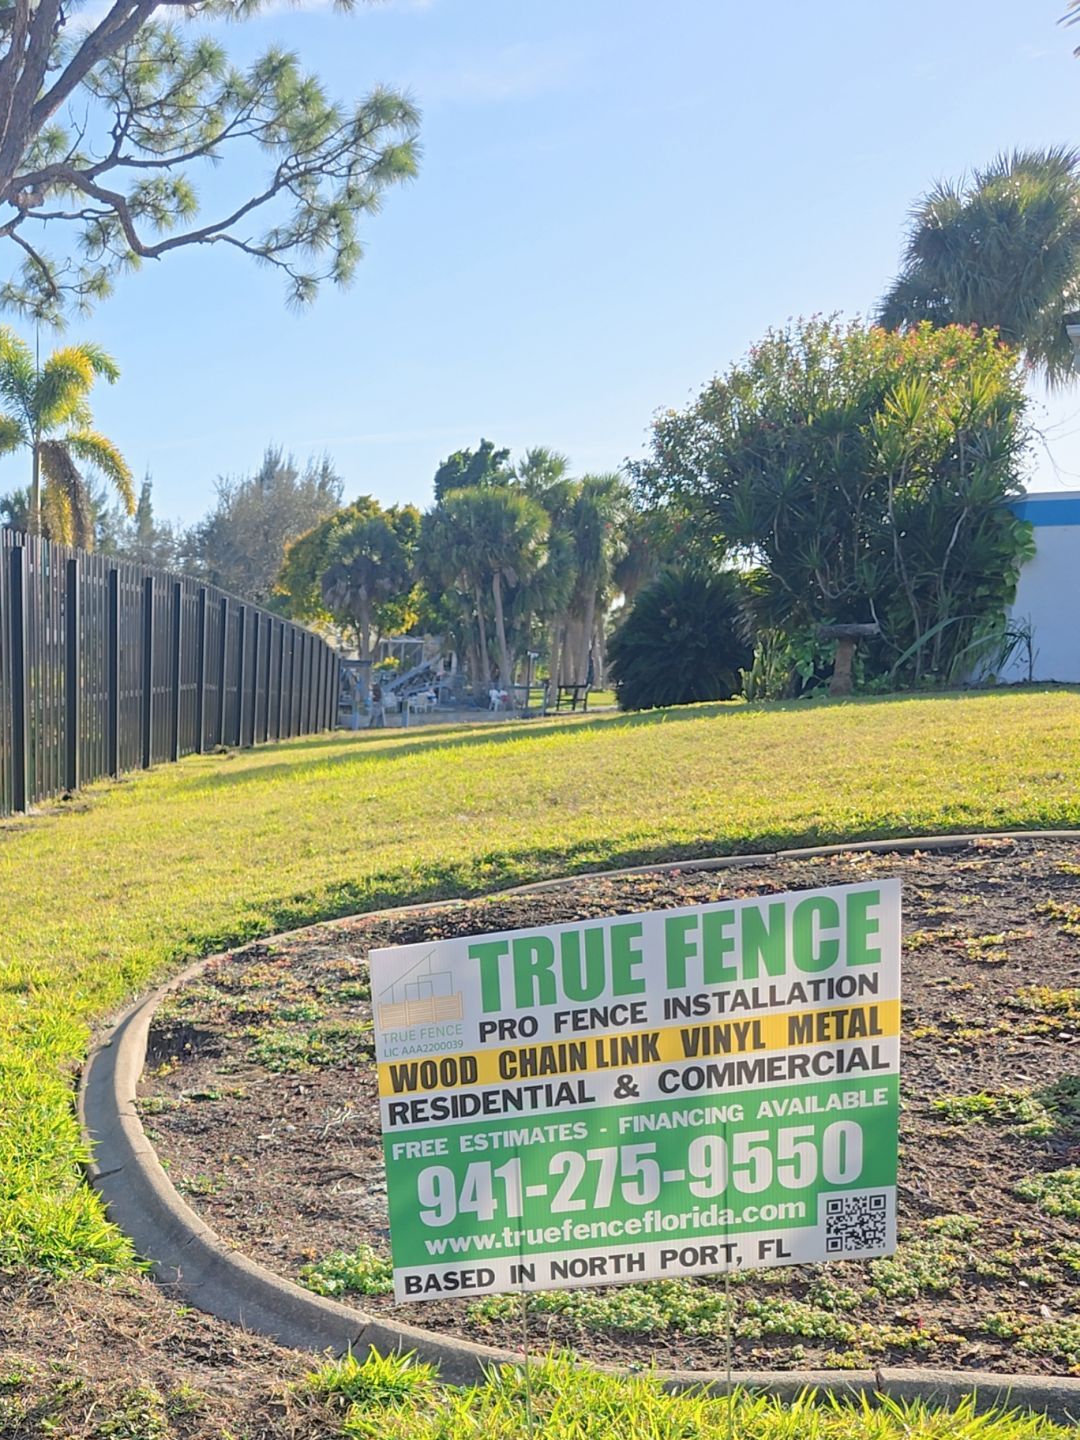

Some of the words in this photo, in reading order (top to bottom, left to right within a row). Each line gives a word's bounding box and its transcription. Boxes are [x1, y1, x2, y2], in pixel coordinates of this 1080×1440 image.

[468, 921, 646, 1013] TRUE
[665, 890, 882, 990] FENCE
[382, 1030, 417, 1044] TRUE
[421, 1024, 463, 1039] FENCE
[479, 1015, 538, 1043] PRO
[554, 1001, 648, 1034] FENCE
[664, 972, 879, 1021] INSTALLATION
[384, 1047, 400, 1057] LIC
[401, 1040, 464, 1056] AAA2200039
[389, 1056, 478, 1093] WOOD
[680, 1021, 766, 1058] VINYL
[787, 1005, 883, 1046] METAL
[388, 1080, 596, 1126] RESIDENTIAL
[613, 1074, 640, 1100] &
[657, 1045, 890, 1094] COMMERCIAL
[392, 1138, 449, 1161] FREE
[460, 1122, 589, 1153] ESTIMATES
[619, 1104, 744, 1135] FINANCING
[756, 1088, 889, 1119] AVAILABLE
[417, 1121, 864, 1228] 941-275-9550
[425, 1201, 806, 1256] www.truefenceflorida.com
[404, 1268, 495, 1296] BASED
[510, 1263, 536, 1286] IN
[550, 1252, 646, 1281] NORTH
[660, 1243, 743, 1270] PORT,
[758, 1239, 791, 1261] FL
